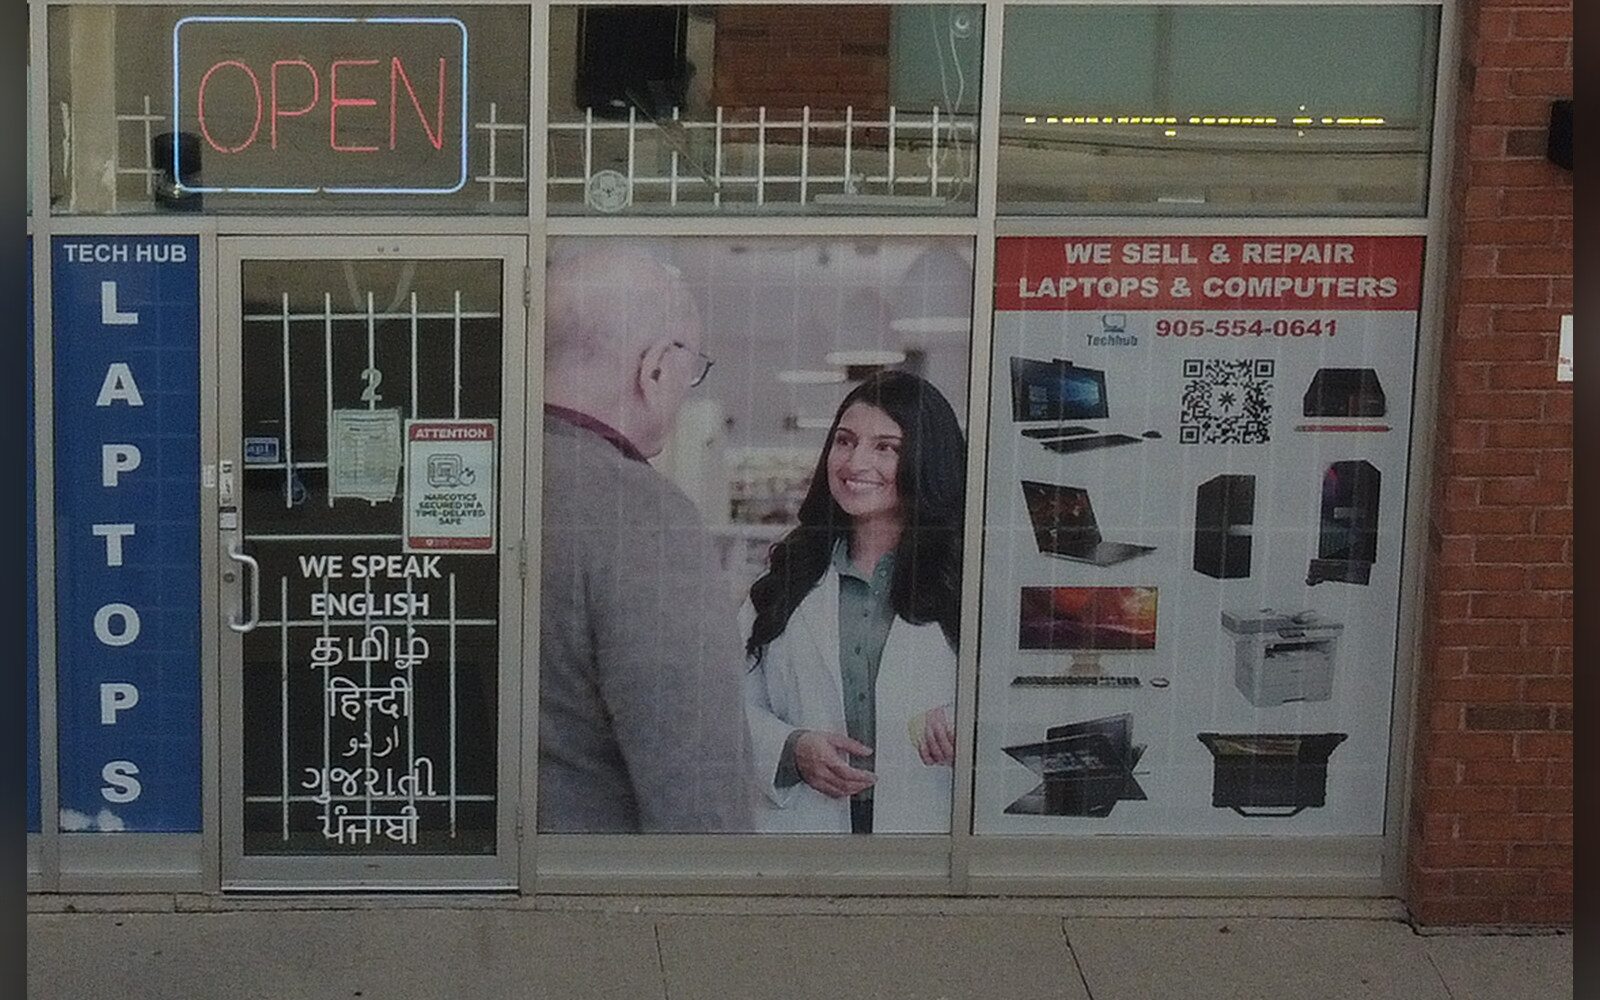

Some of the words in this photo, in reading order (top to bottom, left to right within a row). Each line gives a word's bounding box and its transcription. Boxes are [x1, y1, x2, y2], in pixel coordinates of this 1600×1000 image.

[198, 56, 446, 154] OPEN
[63, 244, 128, 262] TECH
[136, 244, 187, 262] HUB
[1064, 243, 1112, 264] WE
[1122, 243, 1198, 264] SELL
[1209, 243, 1231, 264] &
[1242, 243, 1354, 264] REPAIR
[1019, 277, 1159, 298] LAPTOPS
[1168, 277, 1192, 298] &
[1203, 277, 1398, 299] COMPUTERS
[1155, 319, 1338, 338] 905-554-0641
[1086, 334, 1138, 347] Techhub
[360, 368, 382, 401] 2
[415, 428, 487, 439] ATTENTION
[418, 501, 462, 510] SECURED
[463, 501, 474, 510] IN
[475, 501, 483, 510] A
[424, 493, 478, 501] NARCOTICS
[415, 509, 486, 518] TIME-DELAYED
[439, 517, 462, 526] SAFE
[92, 280, 144, 804] LAPTOPS
[298, 555, 343, 578] WE
[351, 555, 442, 578] SPEAK
[310, 593, 430, 616] ENGLISH
[310, 626, 430, 669] தமிழ்
[327, 676, 412, 721] हिन्दी
[341, 725, 400, 756] اردو
[301, 757, 437, 804] ગુજરાતી
[316, 805, 420, 845] ਪੰਜਾਬੀ
